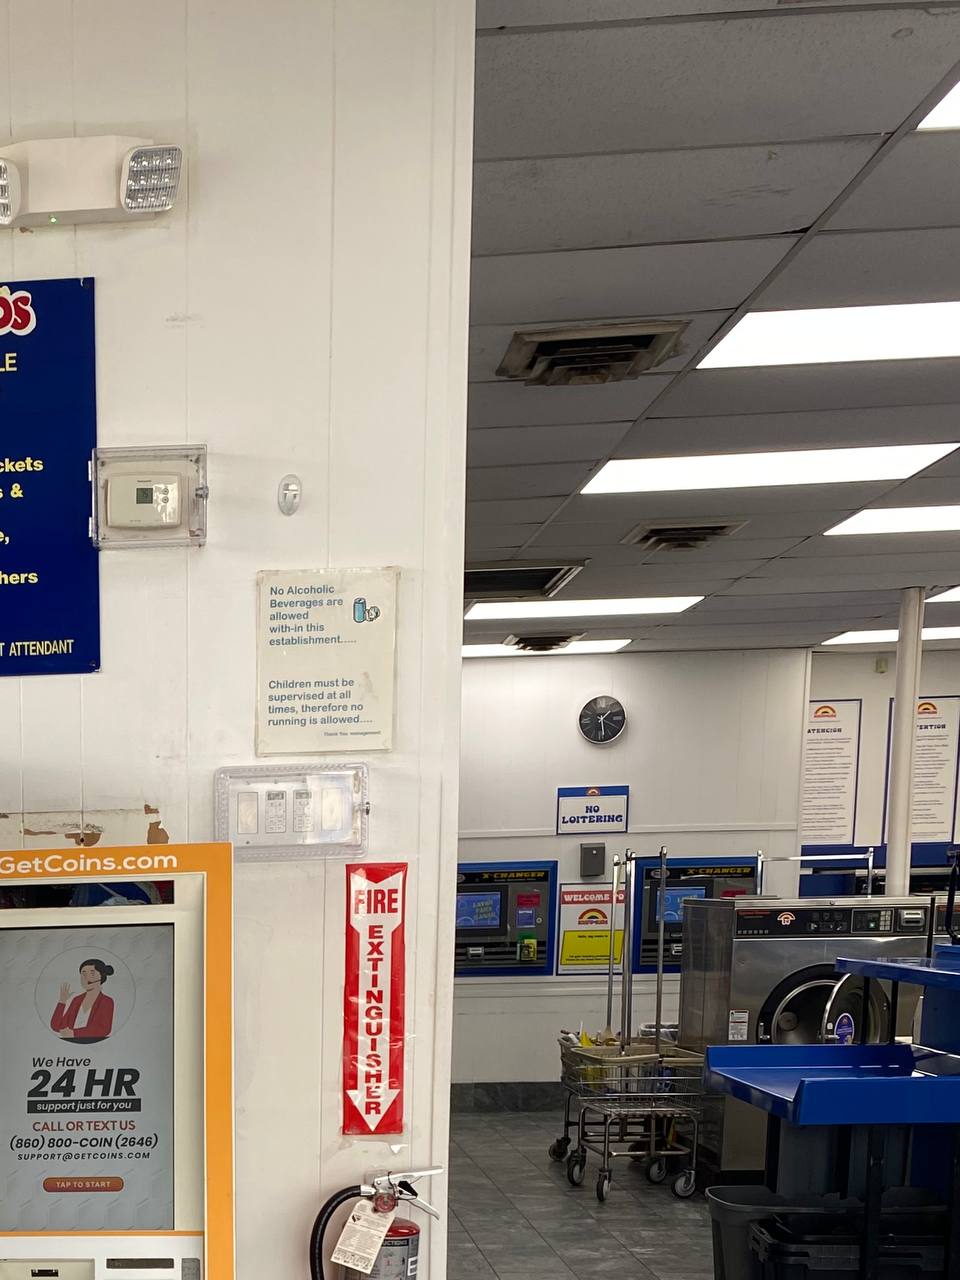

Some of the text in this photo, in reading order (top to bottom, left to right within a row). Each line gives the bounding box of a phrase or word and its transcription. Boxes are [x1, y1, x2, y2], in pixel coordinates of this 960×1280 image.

[270, 584, 335, 595] No Alcoholic
[270, 598, 344, 609] Beverages are
[269, 611, 309, 621] allowed
[269, 623, 325, 633] with-in this
[9, 639, 74, 657] ATTENDANT
[268, 678, 355, 689] Children must be
[268, 690, 351, 703] supervised at all
[268, 703, 363, 714] times, therefore no
[268, 717, 307, 727] running
[309, 716, 318, 725] is
[585, 805, 600, 813] NO
[562, 815, 623, 824] LOITERING
[354, 889, 398, 914] FIRE
[564, 894, 609, 902] WELCOME
[365, 925, 384, 1115] EXTINGUISHER
[32, 1057, 91, 1067] We Have
[27, 1068, 140, 1097] 24 HR
[37, 1101, 132, 1112] support just for you
[32, 1120, 136, 1131] CALL OR TEXT US
[10, 1133, 158, 1150] (860) 800-COIN (2646)
[17, 1152, 151, 1162] SUPPORT@GETCOINS.COM
